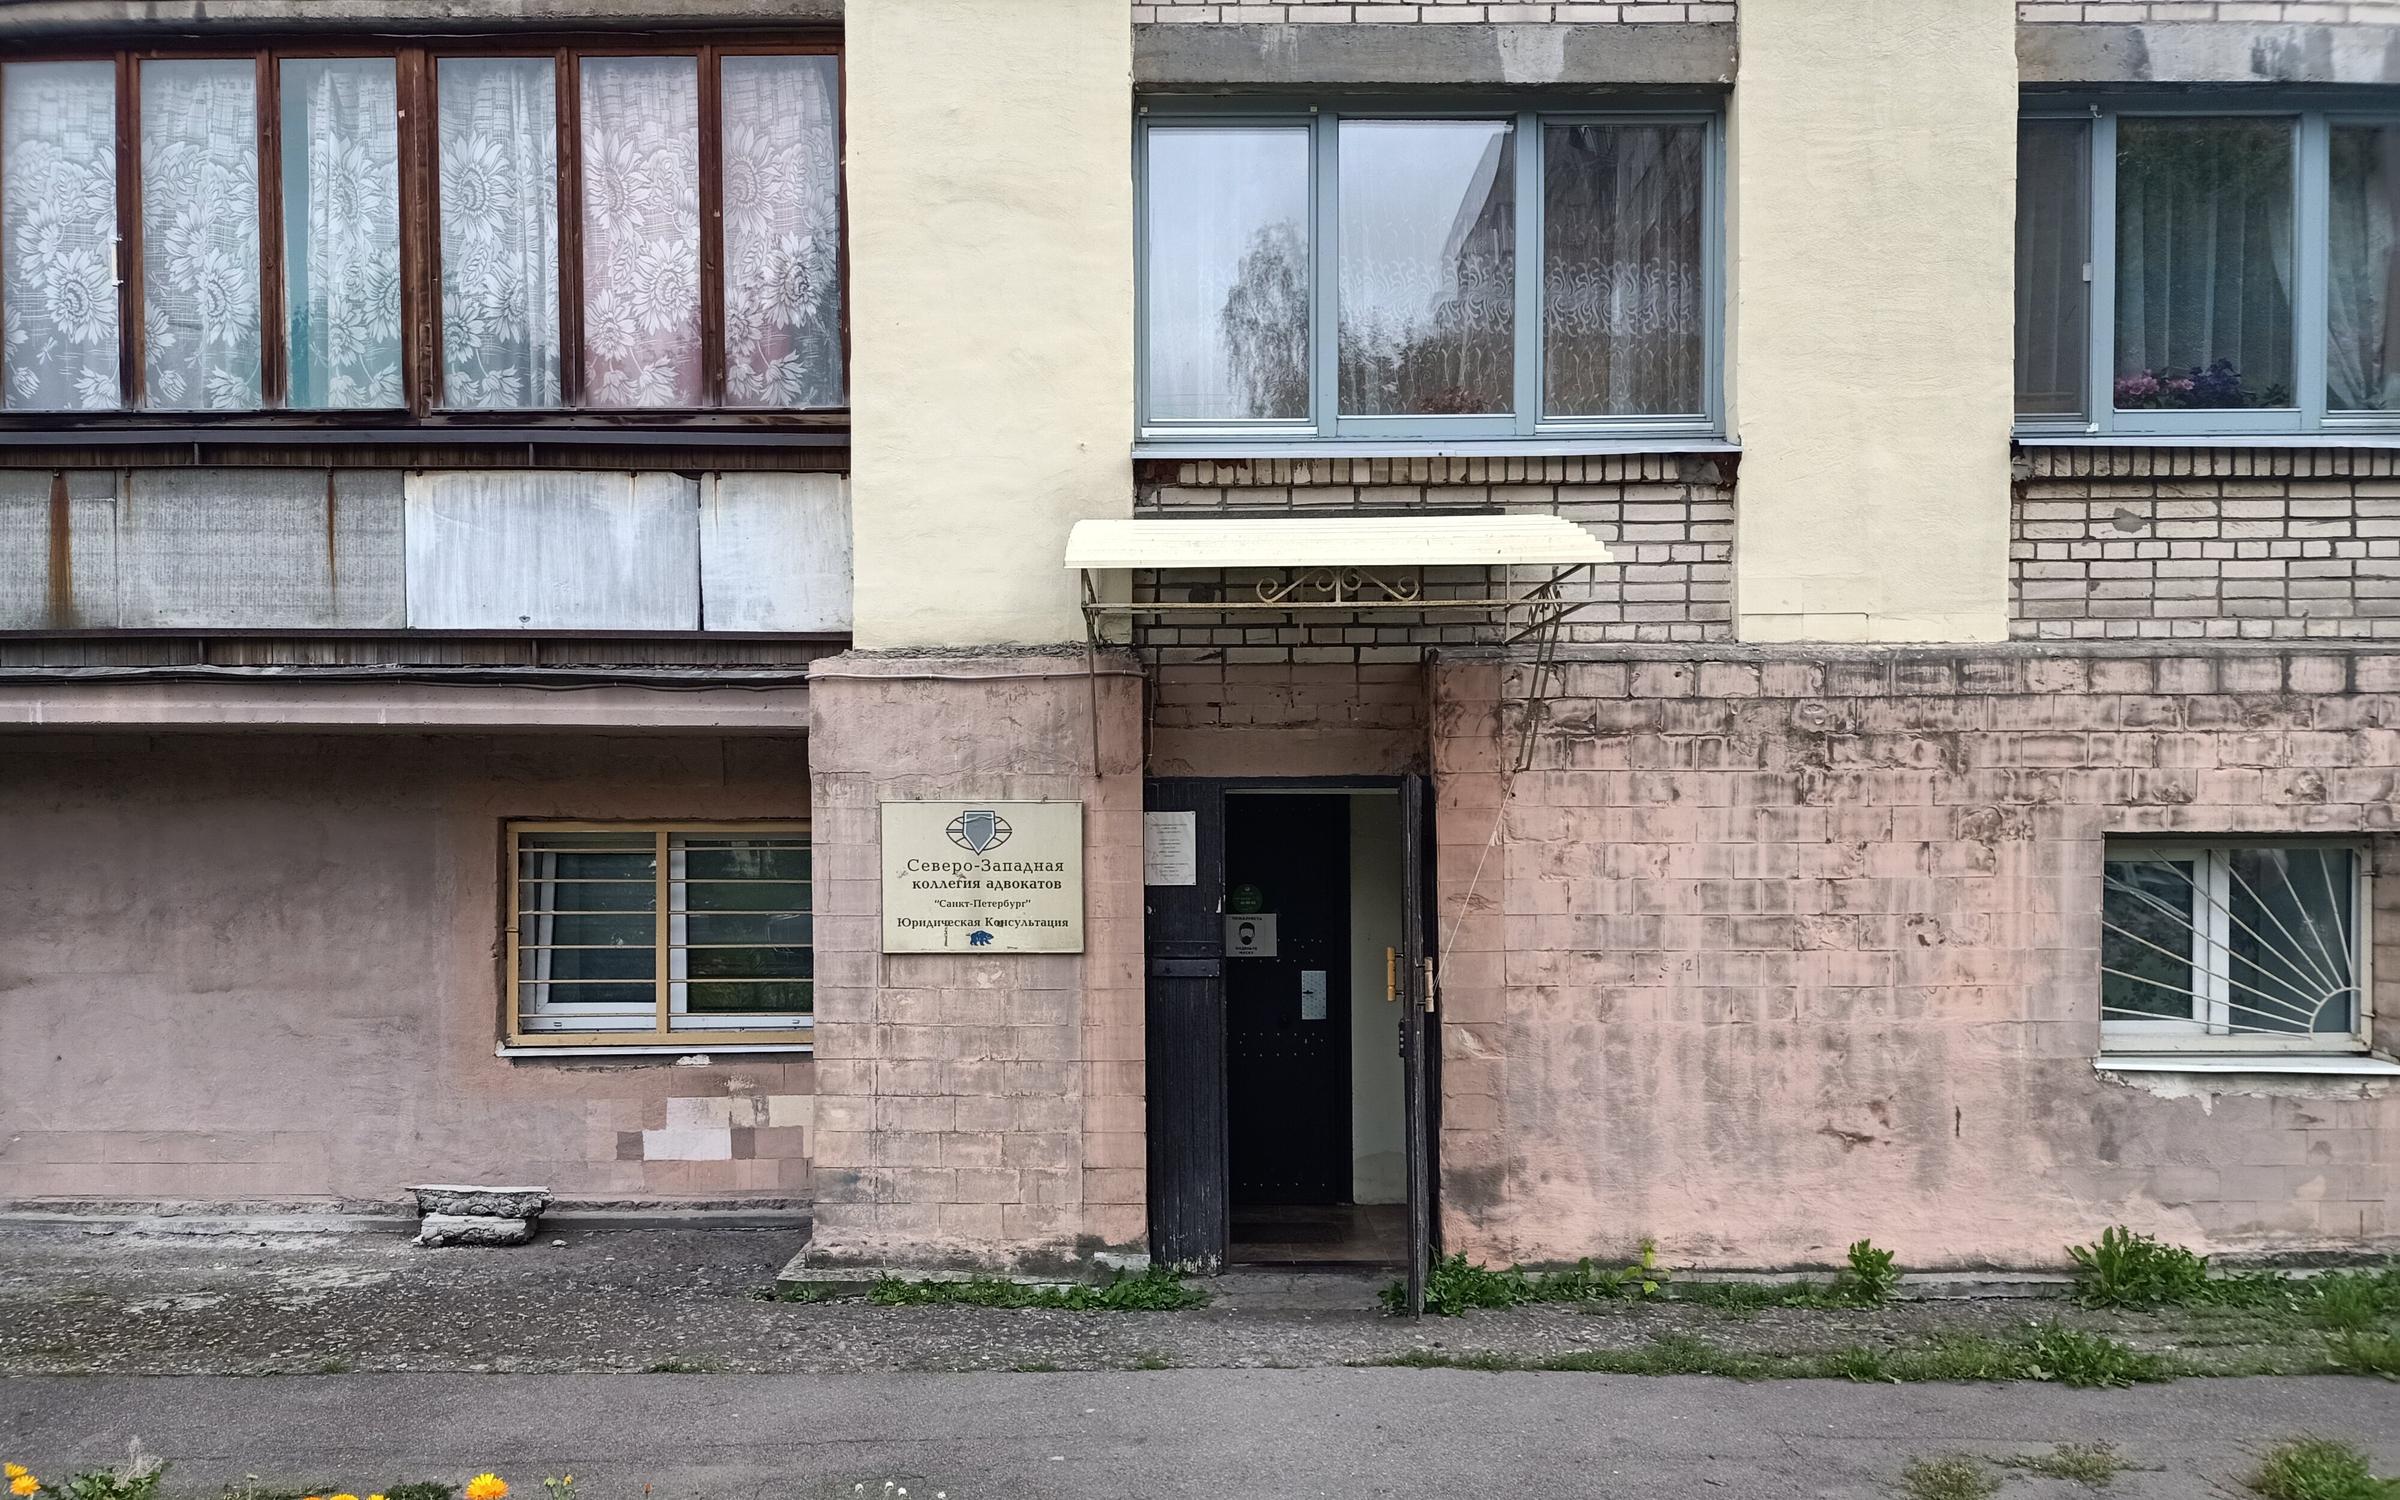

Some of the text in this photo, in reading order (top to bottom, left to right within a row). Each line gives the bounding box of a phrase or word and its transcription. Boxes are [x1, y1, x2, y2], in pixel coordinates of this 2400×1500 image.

[907, 858, 1064, 875] Северо-Западная
[912, 879, 1062, 891] коллегия адвокатов
[897, 917, 1069, 929] Юридическая Консультация
